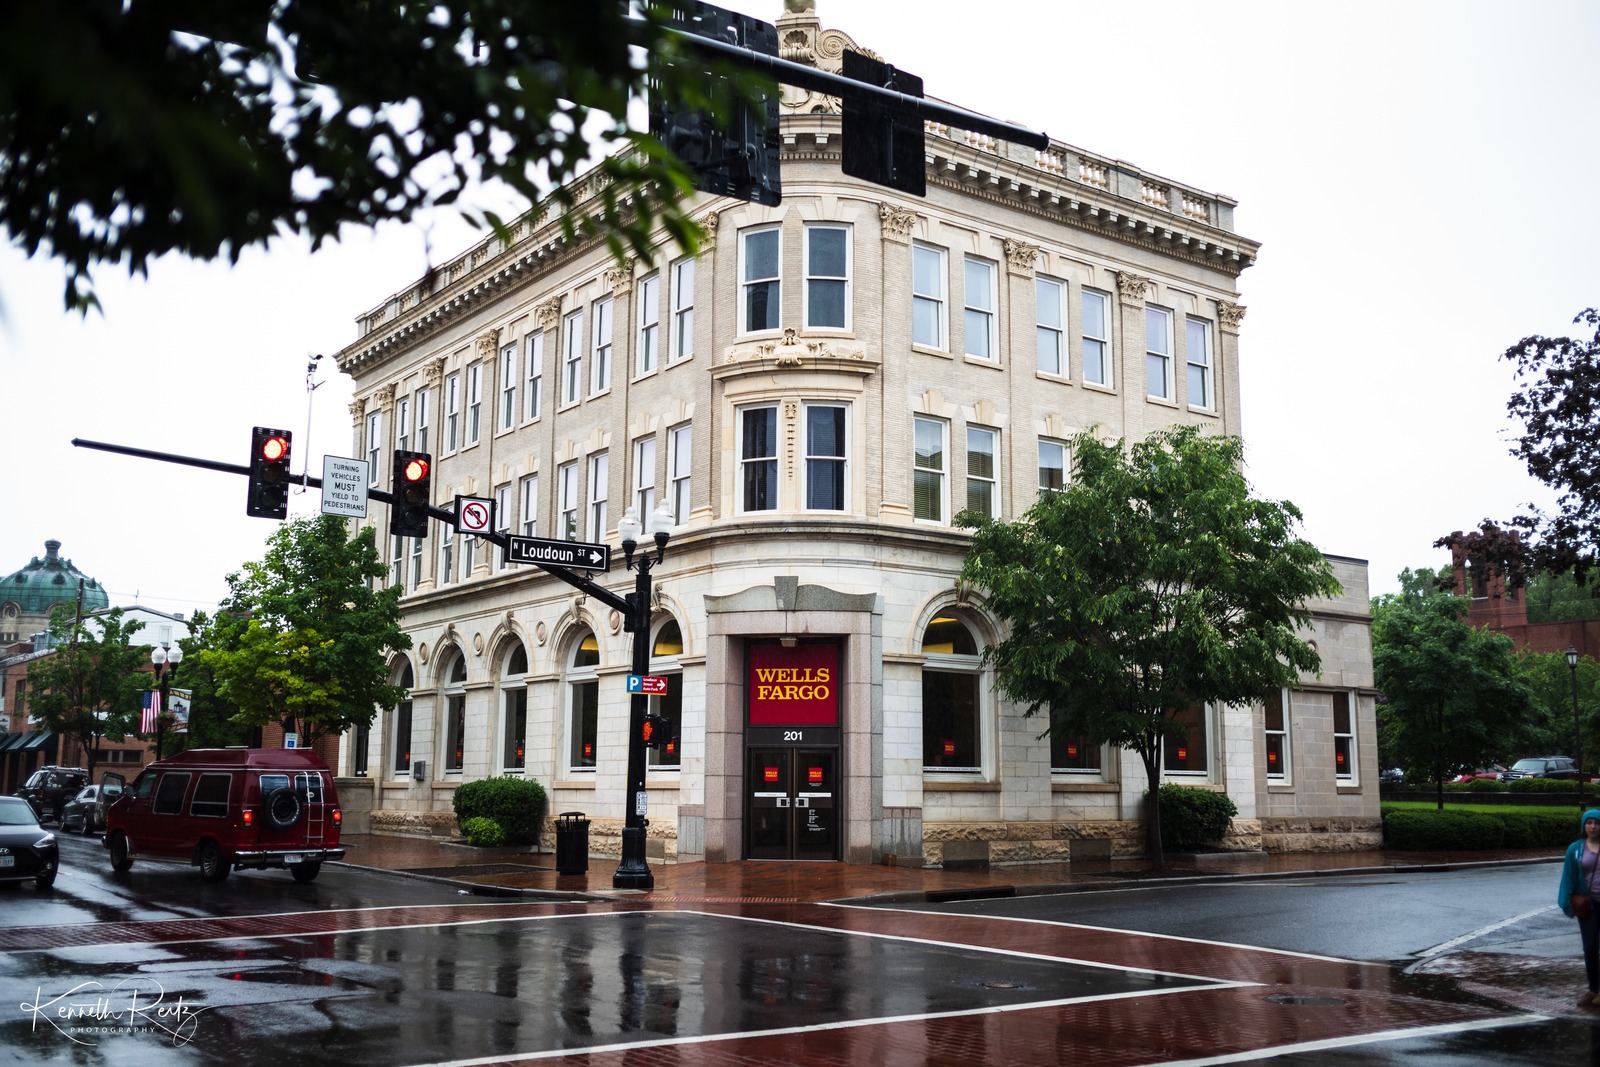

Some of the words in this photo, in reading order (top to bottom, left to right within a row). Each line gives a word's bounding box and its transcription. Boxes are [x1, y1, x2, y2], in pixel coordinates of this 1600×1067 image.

[333, 463, 360, 473] TURNING
[331, 472, 361, 482] VEHICLES
[334, 482, 356, 491] MUST
[331, 492, 348, 500] YIELD
[324, 500, 365, 511] PEDESTRIANS
[513, 542, 519, 550] N
[522, 543, 573, 562] Loudoun
[577, 548, 586, 557] ST
[755, 668, 830, 683] WELLS
[629, 677, 639, 691] P
[757, 685, 830, 700] FARGO
[783, 731, 803, 741] 201
